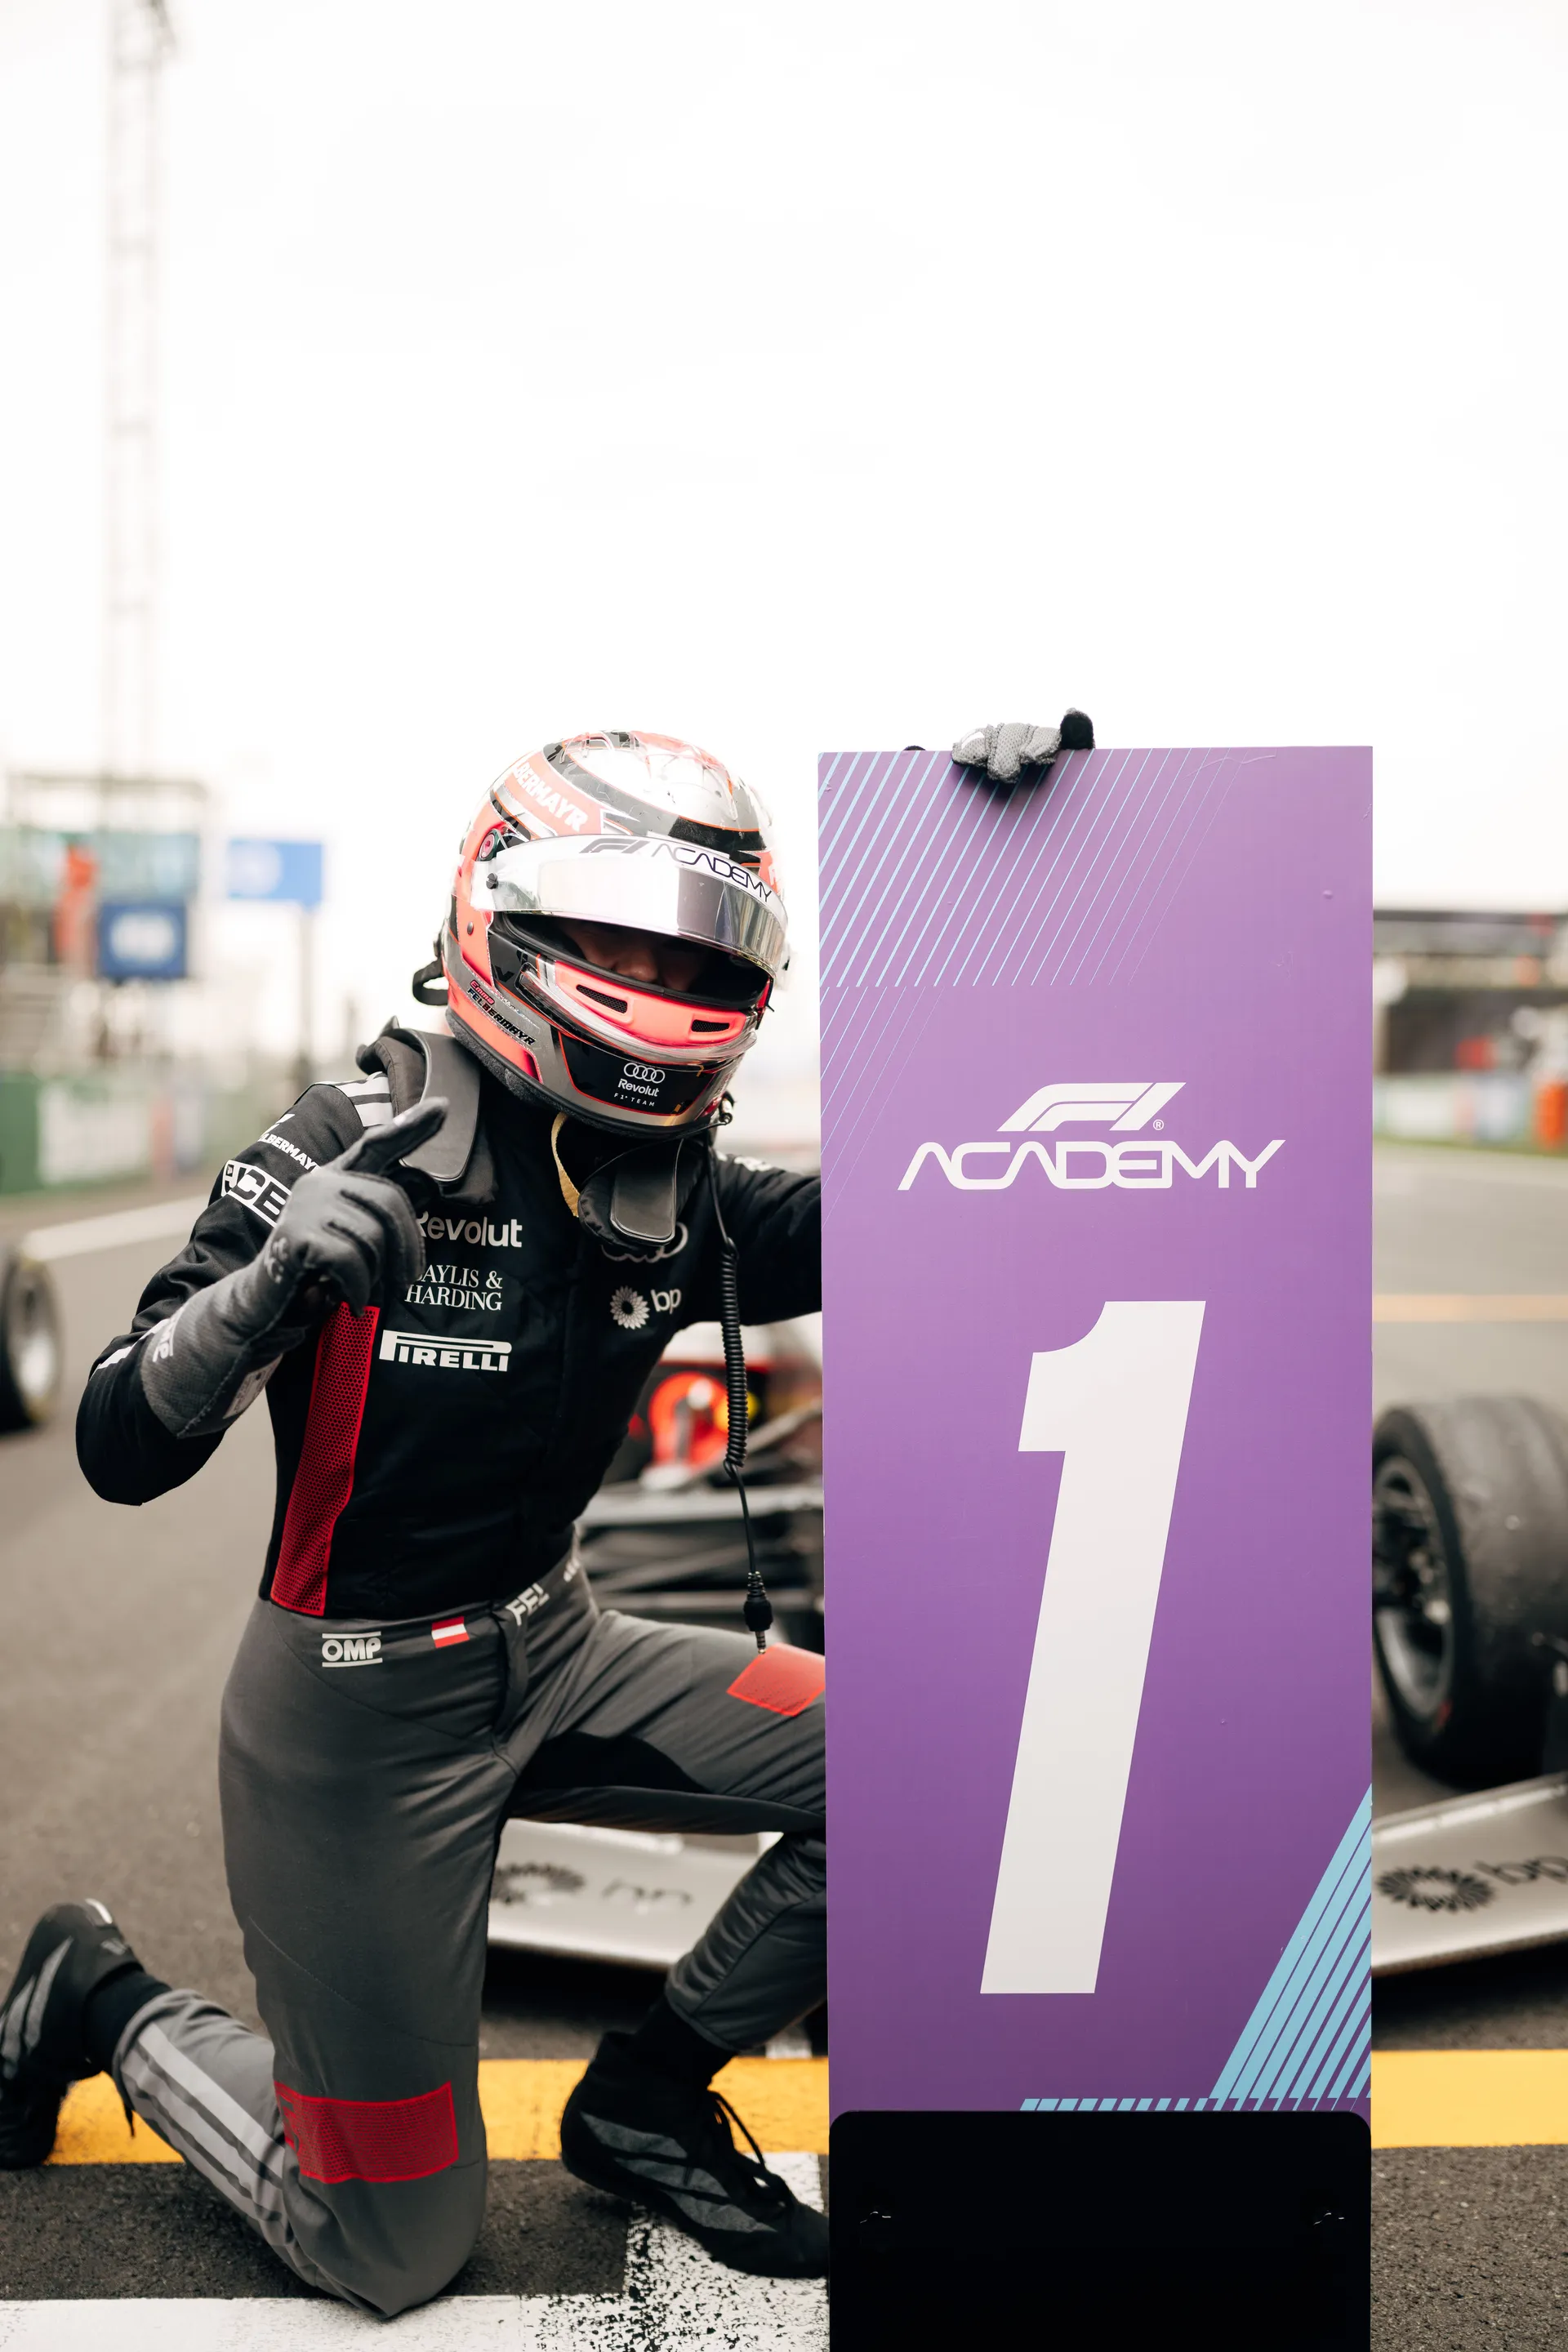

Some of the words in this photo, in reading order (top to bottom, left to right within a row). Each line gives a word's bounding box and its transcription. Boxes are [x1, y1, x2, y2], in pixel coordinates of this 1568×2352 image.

[510, 760, 589, 832] BERMAYR
[579, 838, 650, 854] F1
[651, 843, 773, 902] ACADEMY
[470, 979, 496, 1005] Emma
[617, 1078, 660, 1098] Revolut
[630, 1097, 656, 1107] TEAM
[996, 1082, 1187, 1132] F1
[257, 1133, 320, 1173] LBERMAY
[898, 1139, 1286, 1191] ACADEMY
[416, 1264, 480, 1289] AYLIS
[485, 1270, 503, 1290] &
[404, 1284, 503, 1312] HARDING
[650, 1289, 681, 1315] bp
[379, 1330, 512, 1372] PIRELLI
[322, 1637, 382, 1662] OMP
[980, 1301, 1206, 1993] 1
